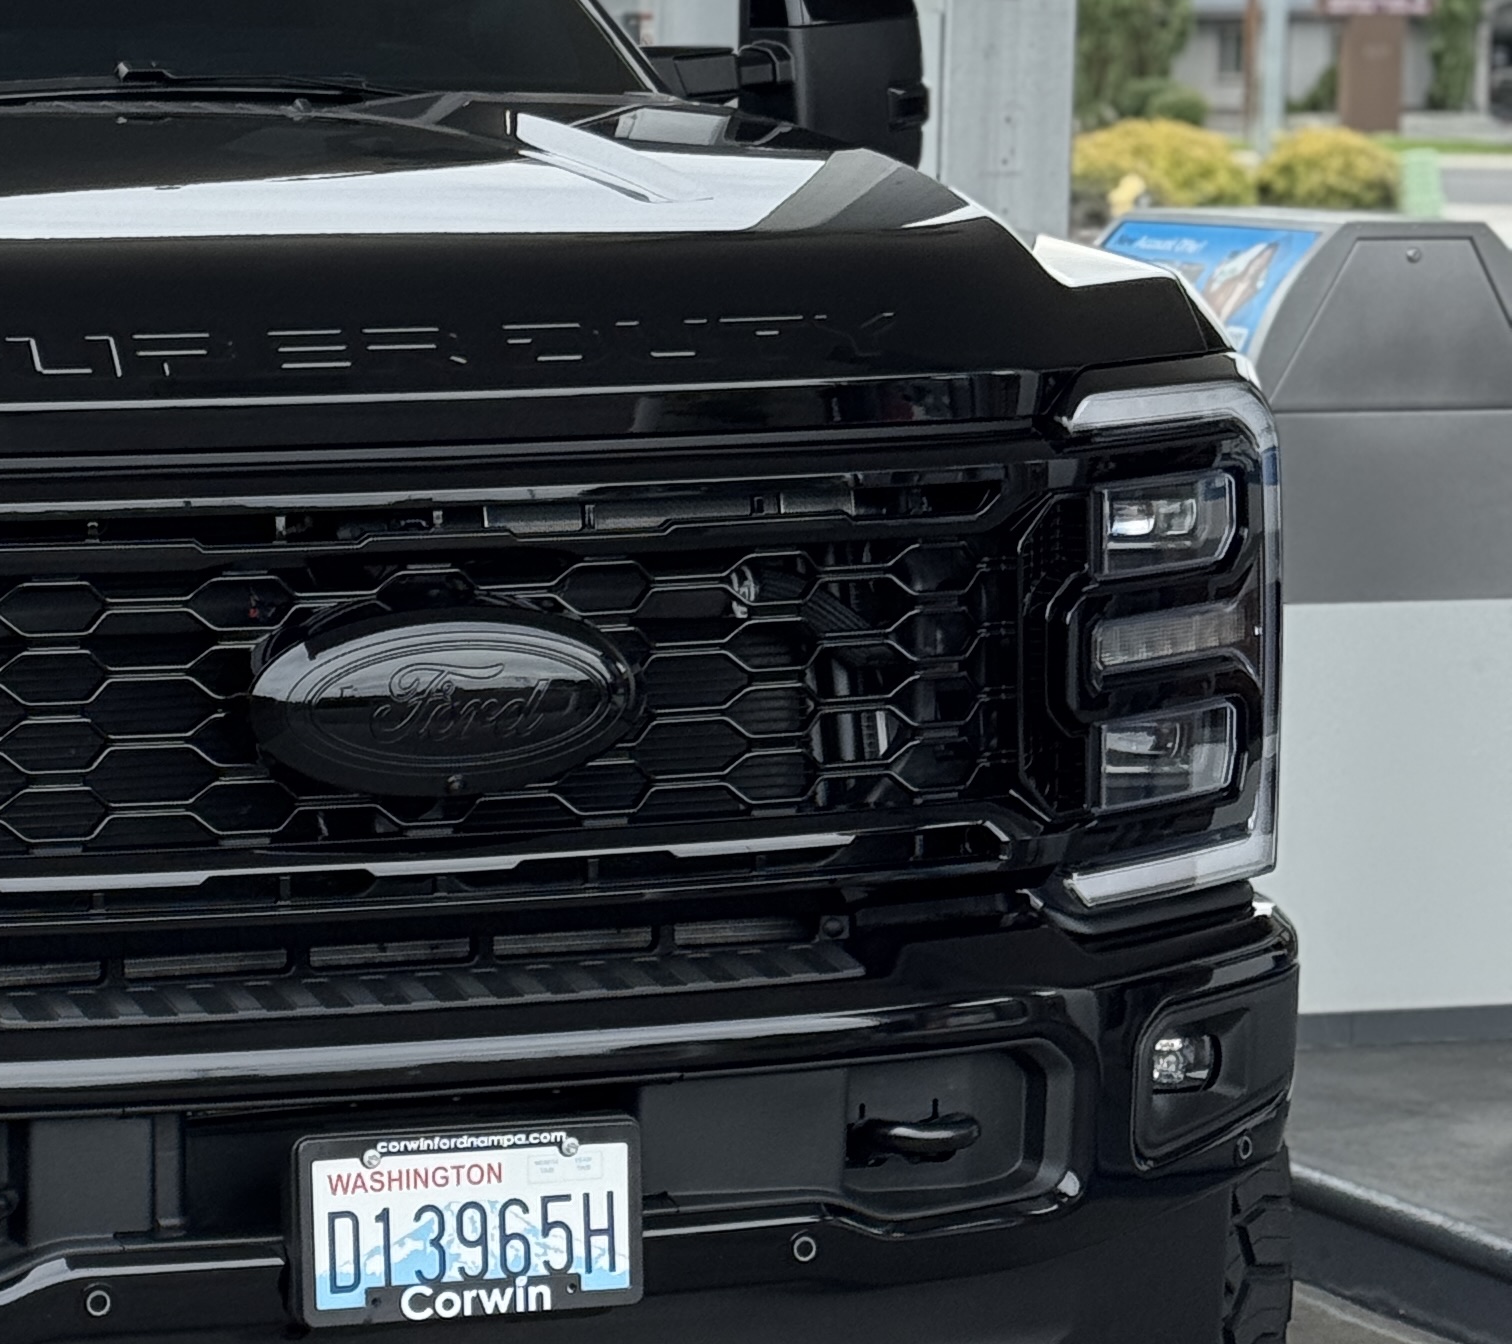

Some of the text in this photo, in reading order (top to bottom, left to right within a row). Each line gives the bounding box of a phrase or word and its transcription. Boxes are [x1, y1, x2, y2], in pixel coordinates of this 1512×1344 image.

[370, 662, 551, 743] Ford
[376, 1130, 568, 1154] corwinfordnampa.com
[327, 1162, 503, 1196] WASHINGTON
[327, 1190, 616, 1295] D13965H
[400, 1275, 552, 1322] Corwin
